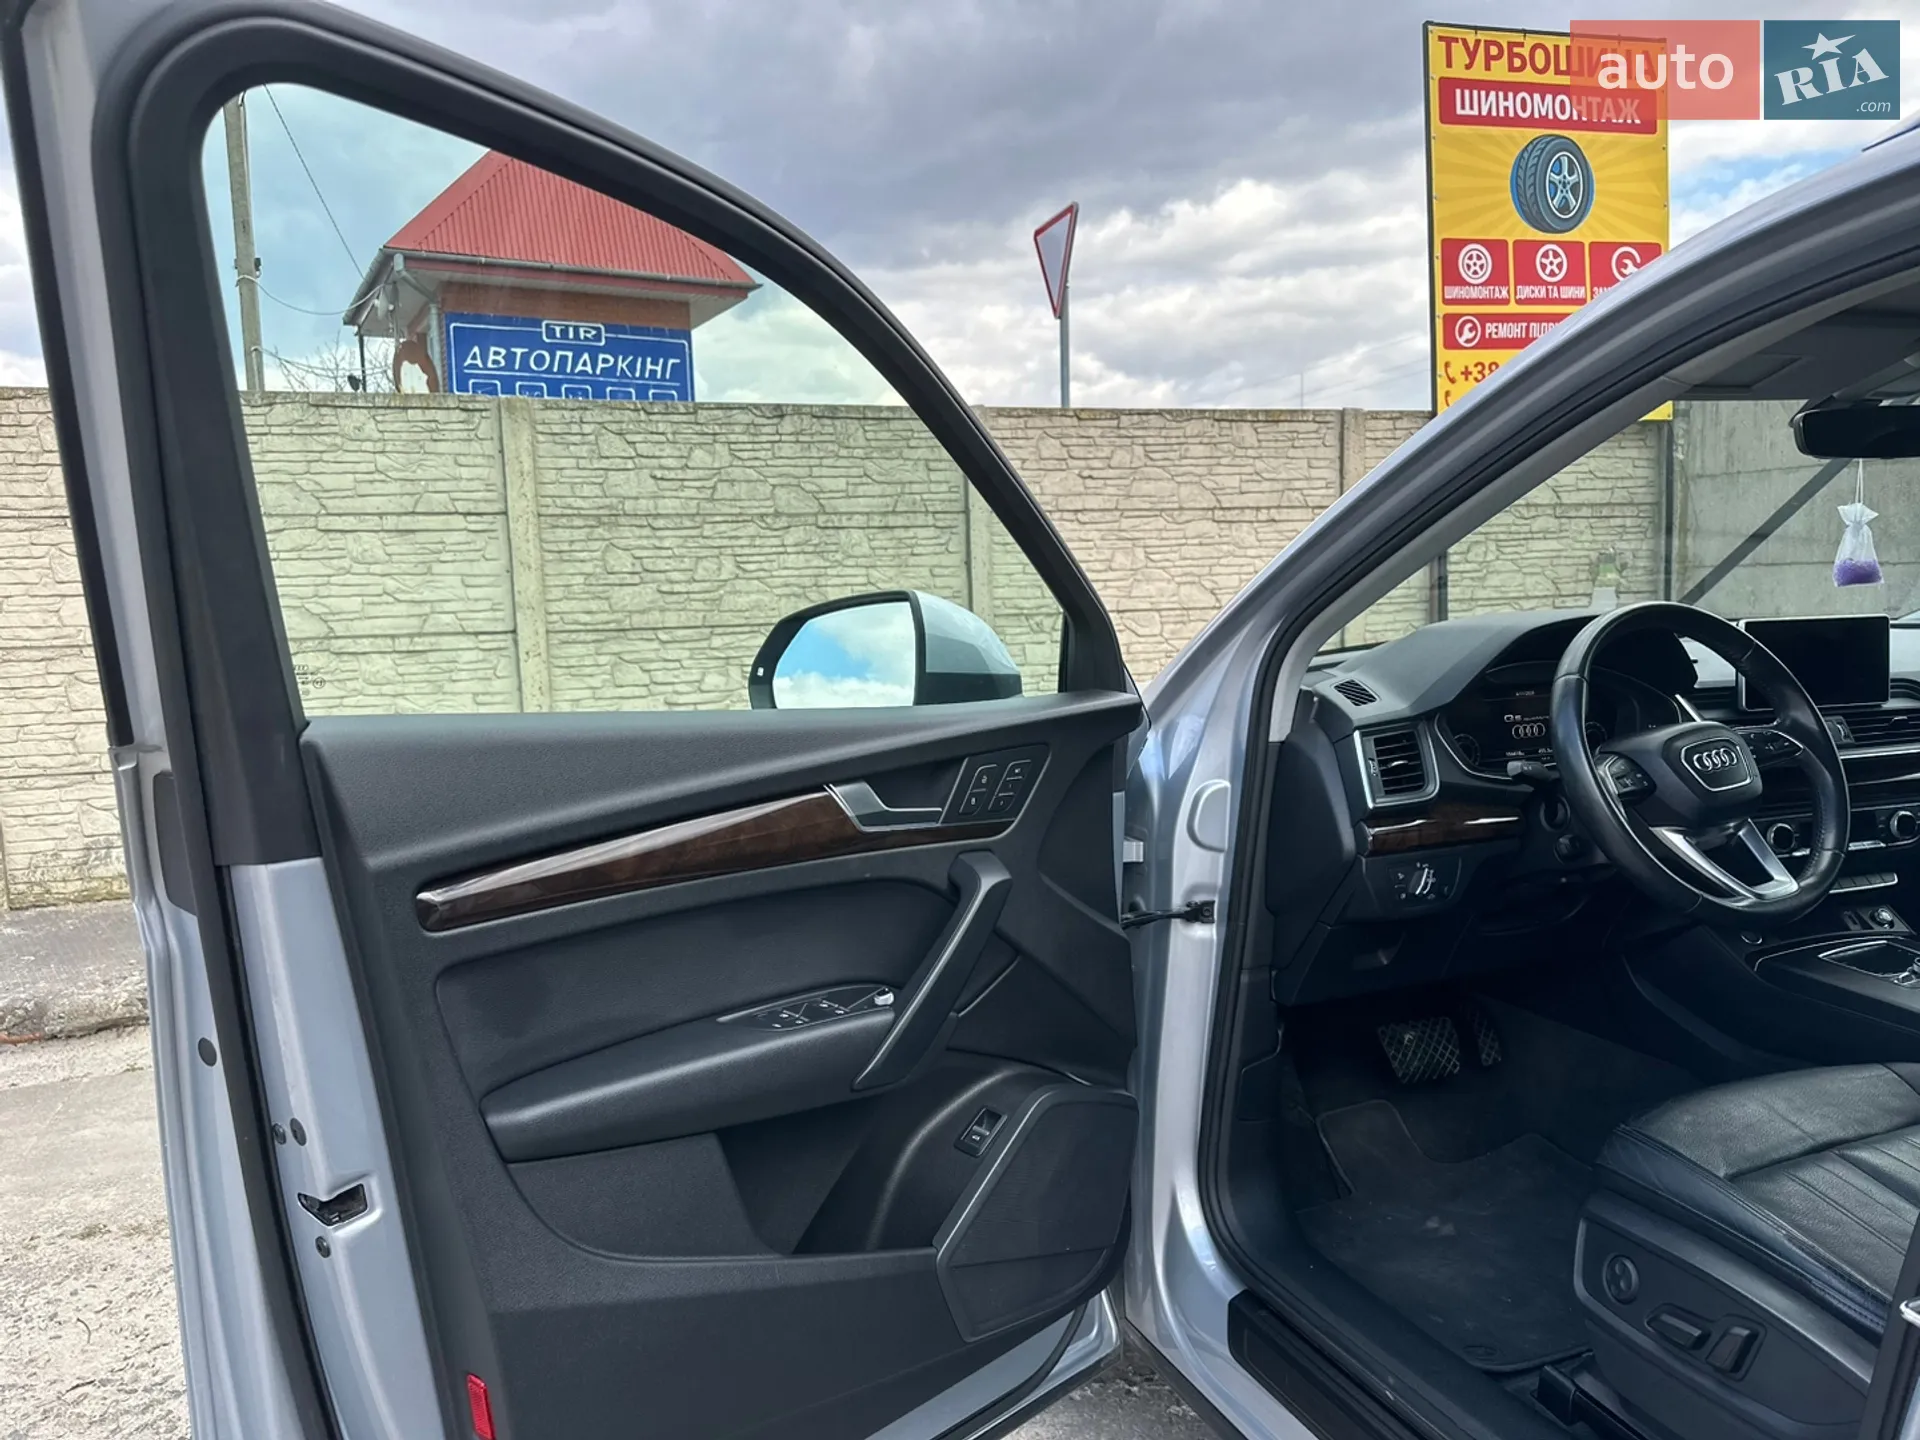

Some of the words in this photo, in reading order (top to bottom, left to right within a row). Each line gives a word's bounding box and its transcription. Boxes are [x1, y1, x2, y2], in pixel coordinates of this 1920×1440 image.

[1455, 88, 1642, 124] ШИНОМОНТАЖ
[1444, 285, 1509, 299] ШИНОМОНТАЖ
[1516, 285, 1546, 299] ДИСКИ
[1548, 285, 1559, 299] ТА
[1560, 285, 1586, 299] ШИНИ
[549, 325, 597, 340] TIR
[1485, 321, 1528, 339] РЕМОНТ
[463, 345, 681, 380] АВТОПАРКІНГ
